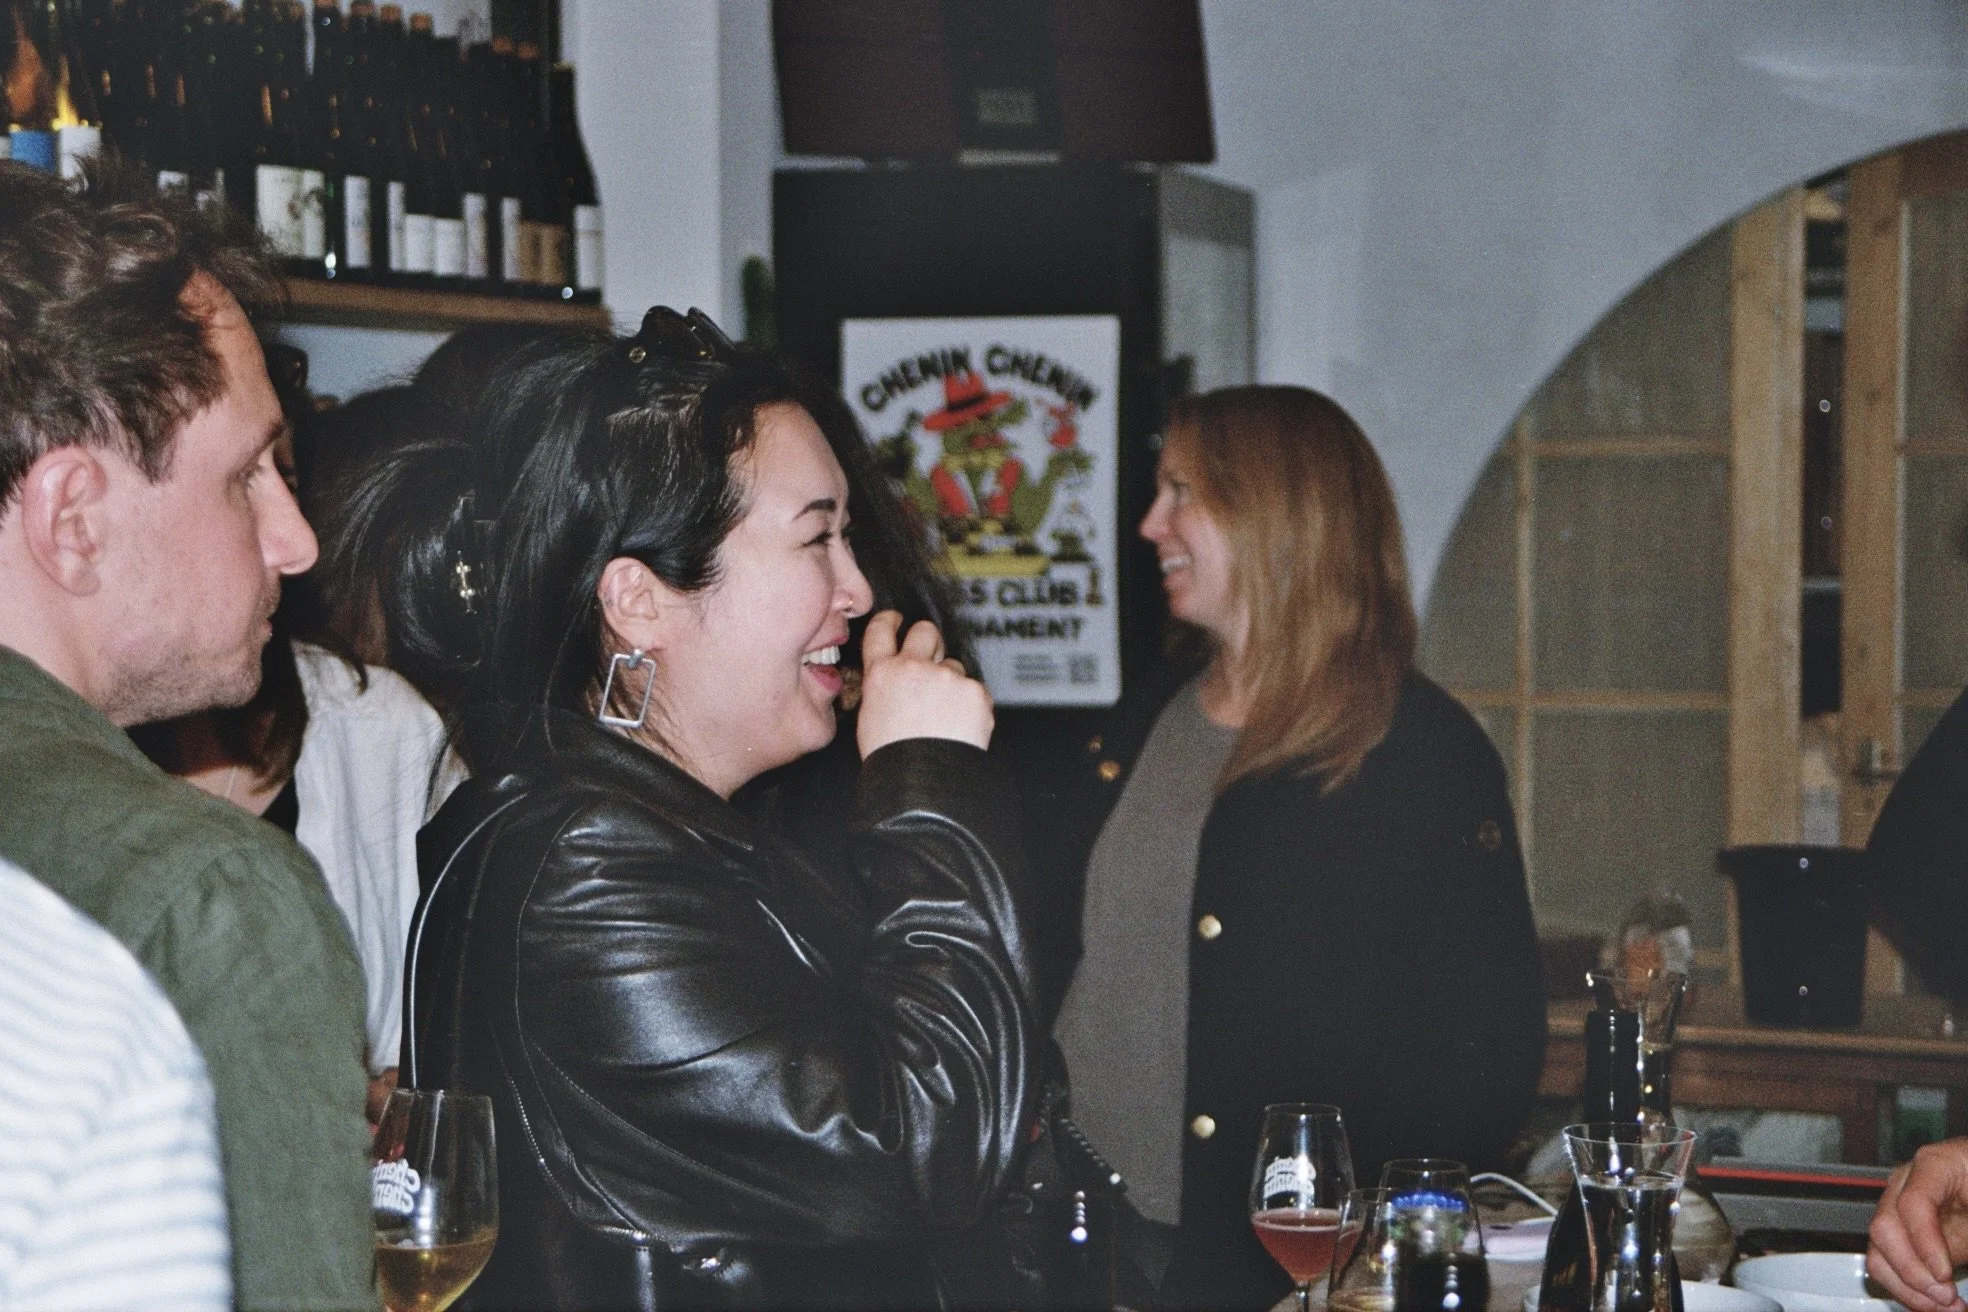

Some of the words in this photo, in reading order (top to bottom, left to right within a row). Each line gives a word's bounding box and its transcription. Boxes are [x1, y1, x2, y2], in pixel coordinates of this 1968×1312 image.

[860, 346, 971, 412] CHENIN
[983, 342, 1097, 411] CHENIN
[998, 577, 1079, 607] CLUB
